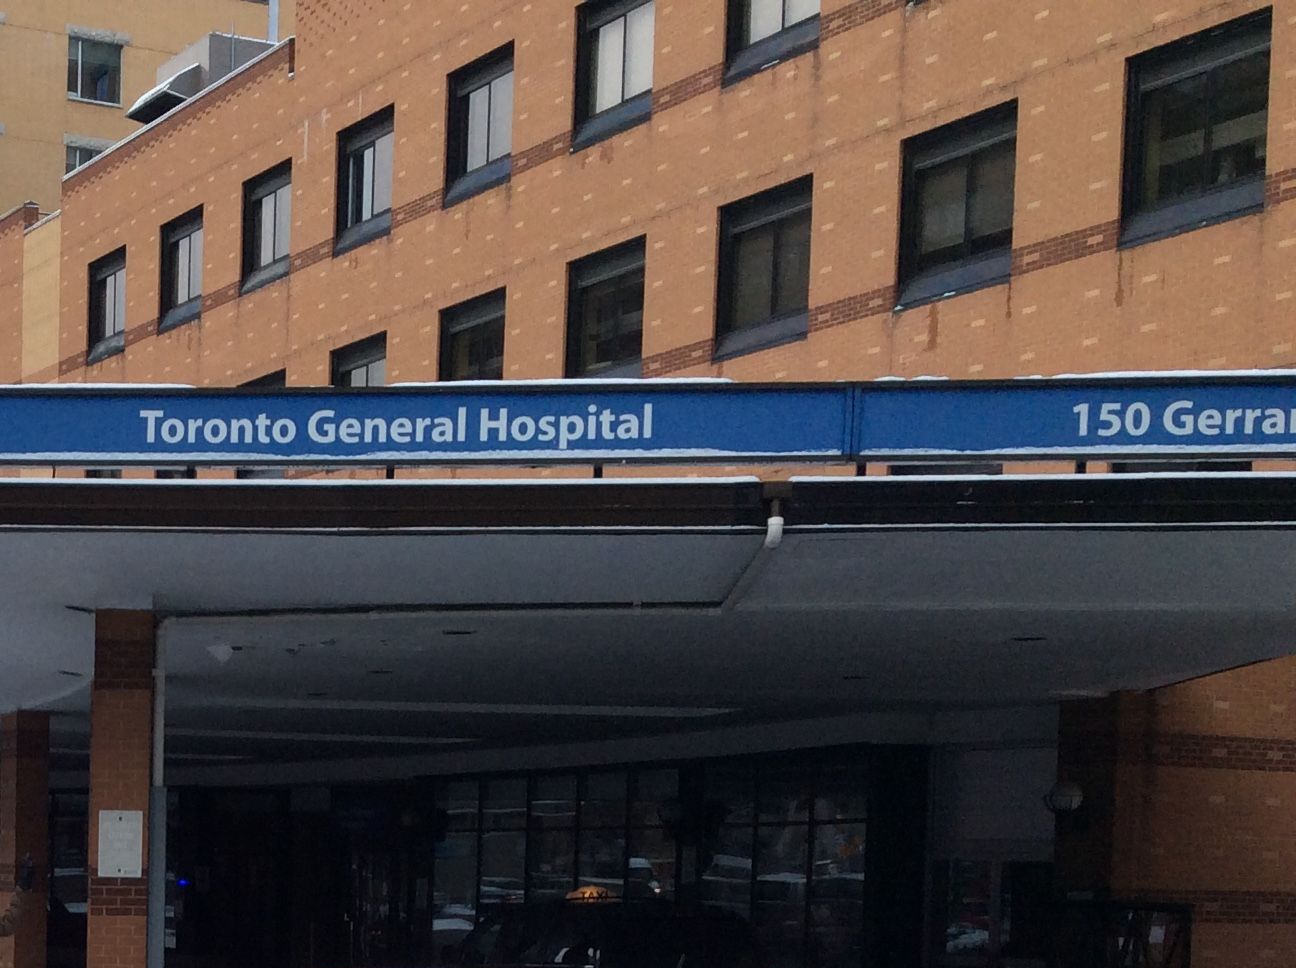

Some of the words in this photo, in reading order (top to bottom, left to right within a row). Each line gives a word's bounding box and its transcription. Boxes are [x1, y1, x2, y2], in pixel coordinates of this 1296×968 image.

[140, 410, 297, 444] Toronto
[308, 407, 467, 443] General
[479, 403, 652, 449] Hospital
[1073, 402, 1151, 436] 150
